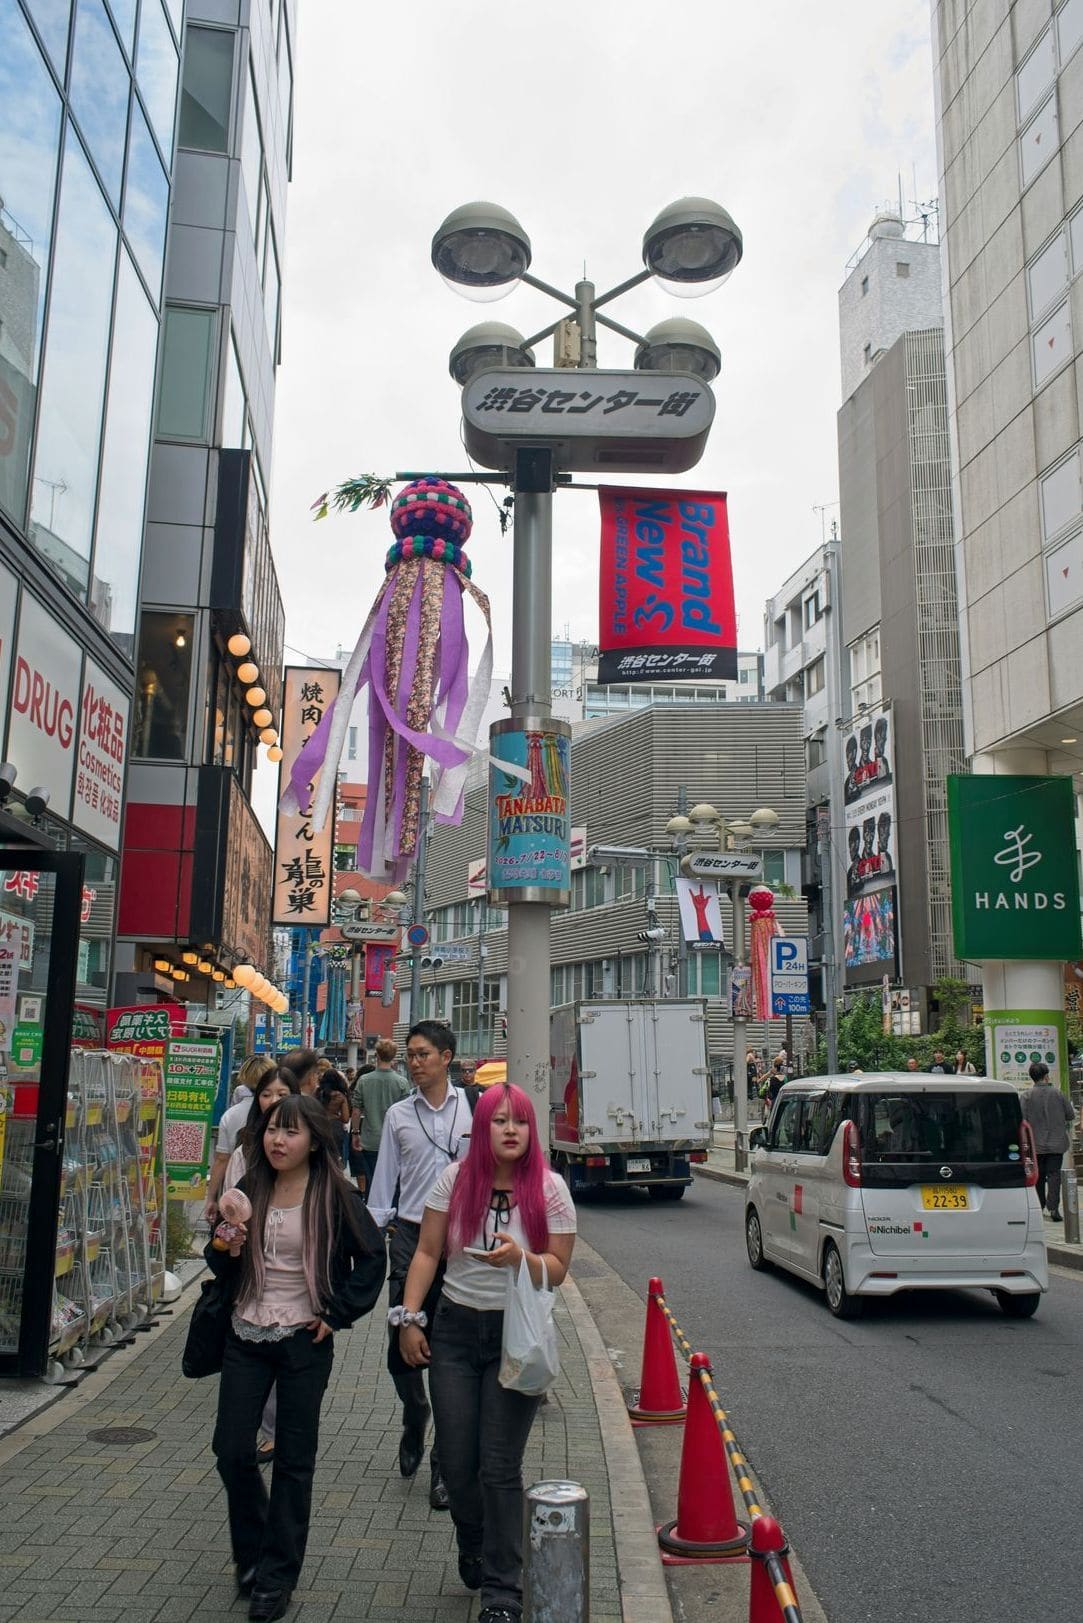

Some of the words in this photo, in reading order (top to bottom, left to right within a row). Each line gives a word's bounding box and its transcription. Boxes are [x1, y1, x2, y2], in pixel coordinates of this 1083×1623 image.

[476, 387, 701, 417] 渋谷センター街
[615, 517, 628, 570] GREEN
[632, 497, 674, 589] New
[679, 499, 722, 637] Brand
[613, 573, 627, 634] APPLE
[617, 653, 717, 669] 渋谷センター街
[13, 656, 73, 749] DRUG
[301, 682, 324, 726] 焼肉
[83, 683, 124, 764] 化粧品
[79, 741, 121, 794] Cosmetics
[77, 771, 99, 810] 화장품
[495, 793, 567, 819] TANABATA
[500, 814, 568, 841] MATSURI
[693, 857, 760, 870] 渋谷センター街
[281, 848, 326, 914] 龍の巣
[976, 893, 1066, 909] HANDS
[776, 942, 798, 970] P
[785, 962, 805, 971] 24H
[788, 1004, 807, 1012] 100m
[167, 1090, 210, 1103] 扫码有礼
[877, 1226, 911, 1235] Nichibei
